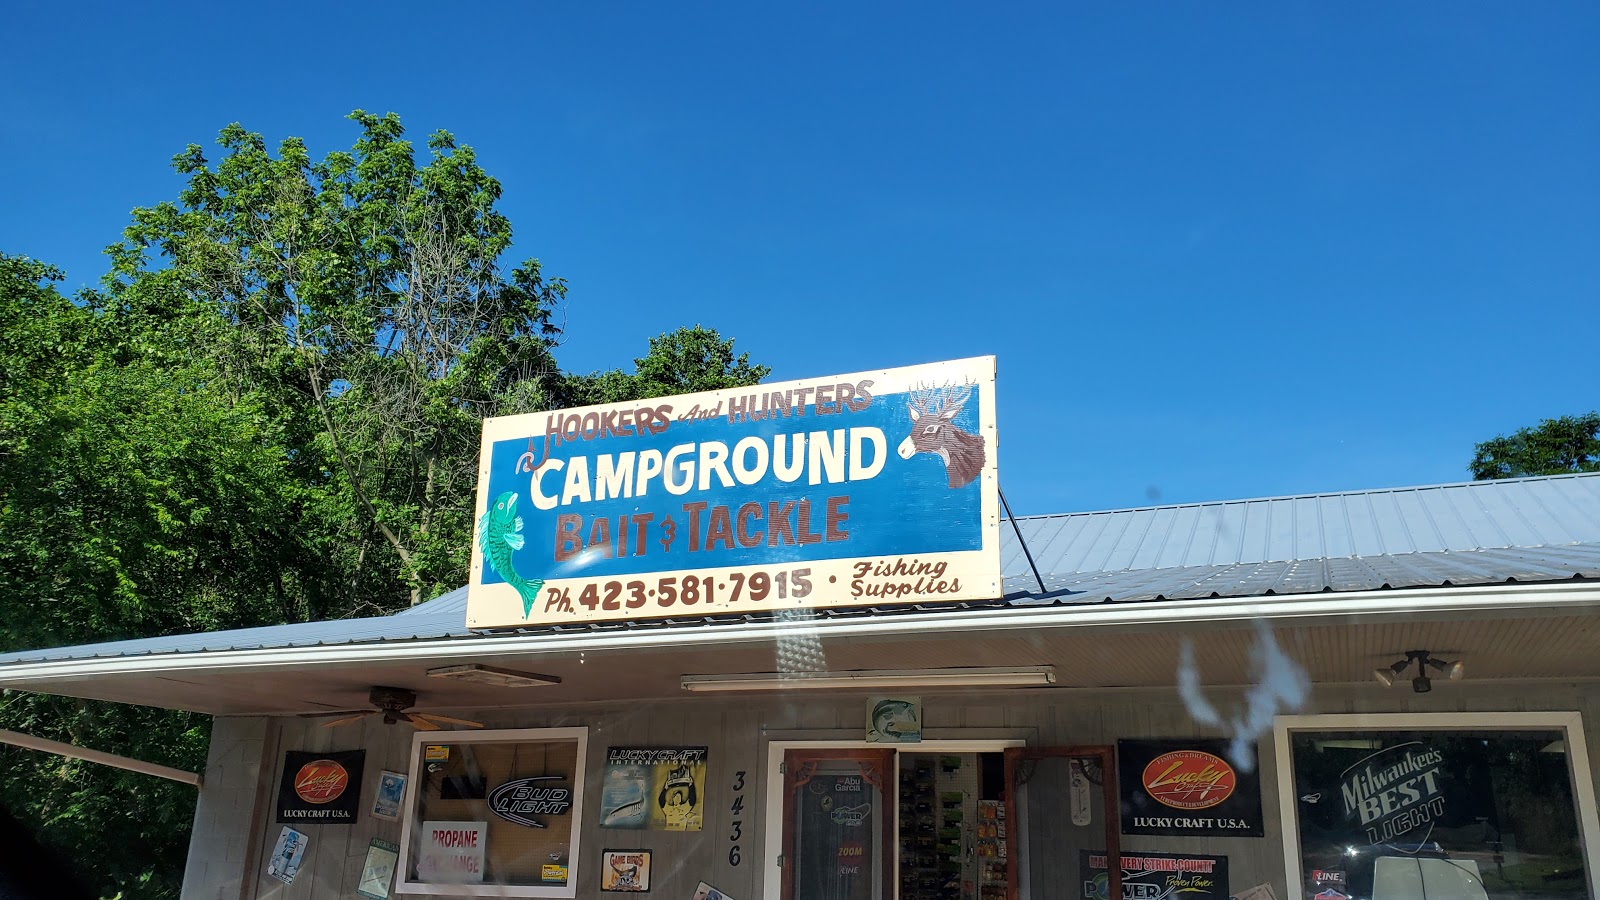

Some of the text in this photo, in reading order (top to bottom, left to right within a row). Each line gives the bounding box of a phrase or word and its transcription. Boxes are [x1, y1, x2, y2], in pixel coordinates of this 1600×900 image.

[540, 379, 875, 460] HOOKERS And HUNTERS
[530, 426, 887, 511] CAMPGROUND
[554, 513, 654, 563] BAIT
[682, 496, 849, 552] TACKLE
[853, 558, 948, 579] Fishing
[851, 577, 962, 599] Supplies
[835, 784, 861, 792] Garcia
[844, 777, 861, 785] Abu
[1147, 761, 1230, 800] Lucky
[1341, 748, 1442, 816] Milwaukee's
[511, 786, 568, 801] BUD
[1358, 767, 1440, 826] BEST
[284, 810, 307, 818] LUCKY
[308, 810, 331, 818] CRAFT
[496, 798, 569, 814] LIGHT
[1133, 817, 1251, 829] LUCKY CRAFT U.S.A.
[1366, 796, 1445, 846] LIGHT
[432, 830, 478, 848] PROPANE
[838, 847, 862, 856] ZOOM
[1120, 857, 1143, 870] VERY
[1144, 858, 1177, 871] STRIKE
[1165, 875, 1190, 887] Proven
